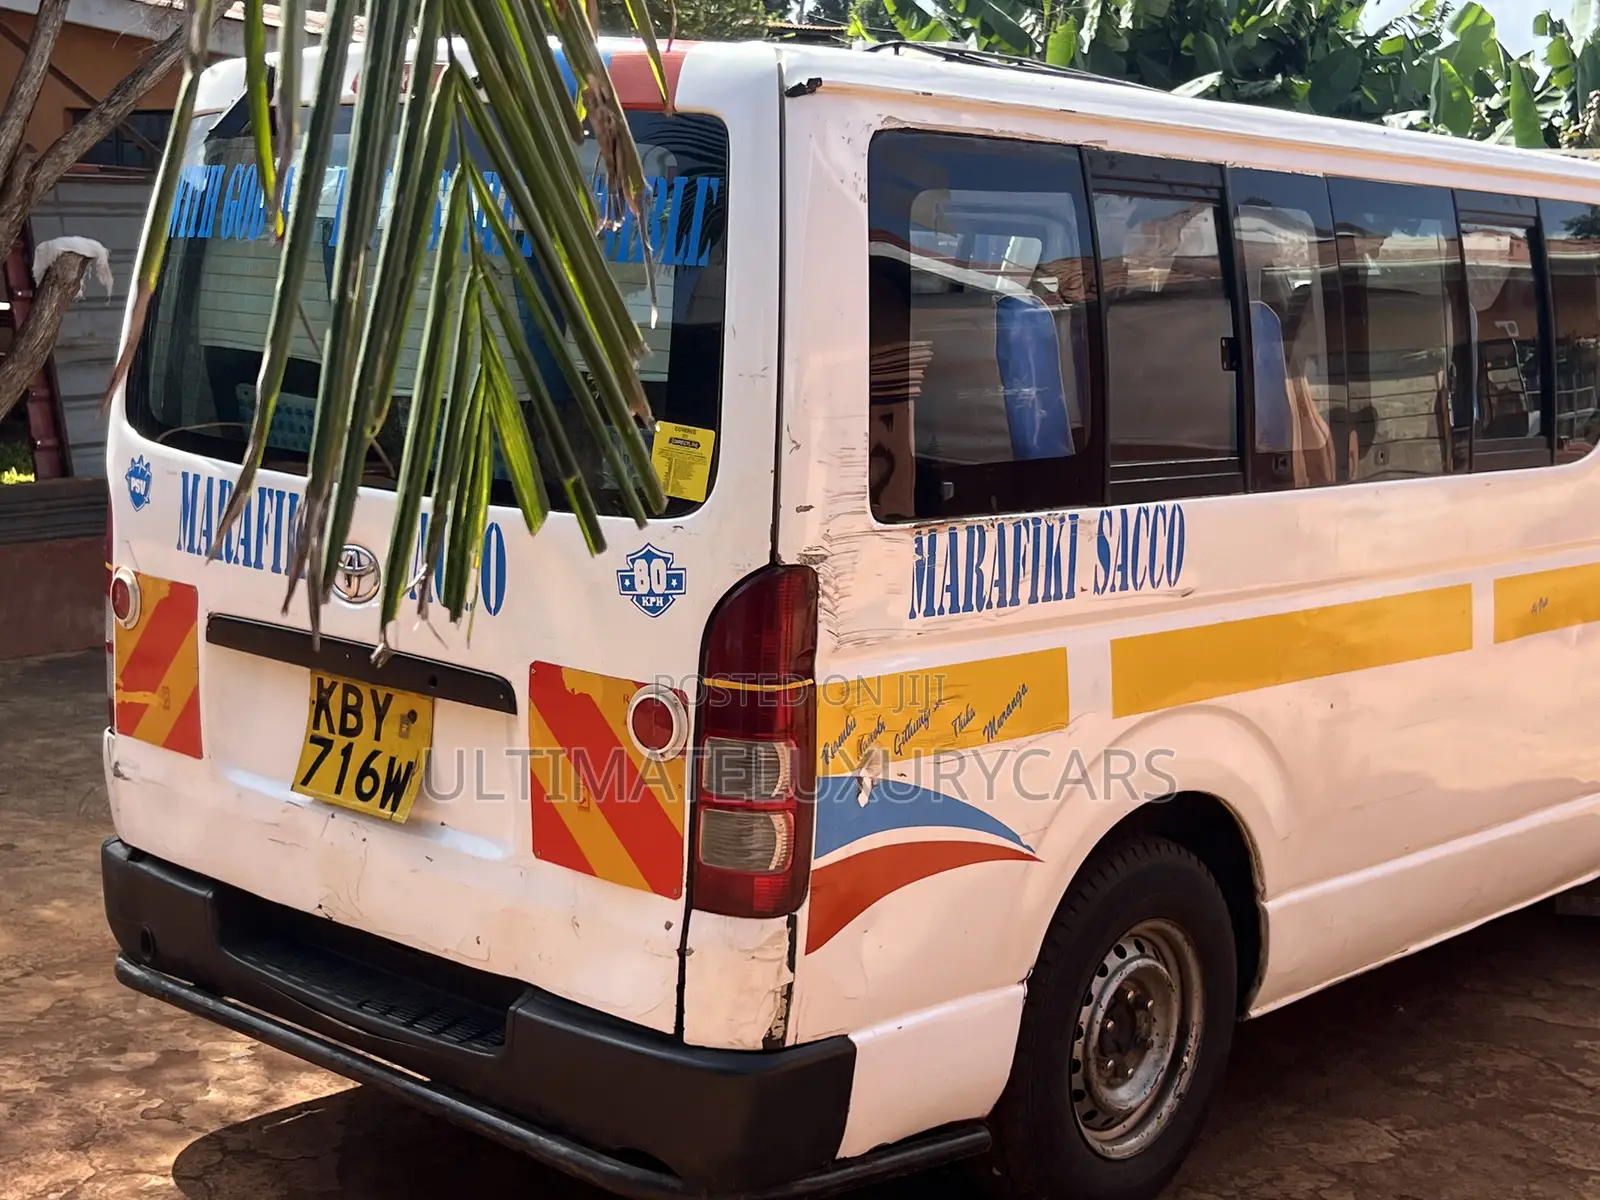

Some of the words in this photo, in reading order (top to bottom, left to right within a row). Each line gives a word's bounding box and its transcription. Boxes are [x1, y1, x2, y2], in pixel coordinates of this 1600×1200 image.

[634, 558, 667, 594] 80
[908, 513, 1079, 620] MARAFIKI
[1093, 503, 1186, 596] SACCO
[642, 596, 664, 607] KPH
[312, 677, 394, 742] KBY
[300, 733, 414, 812] 716W
